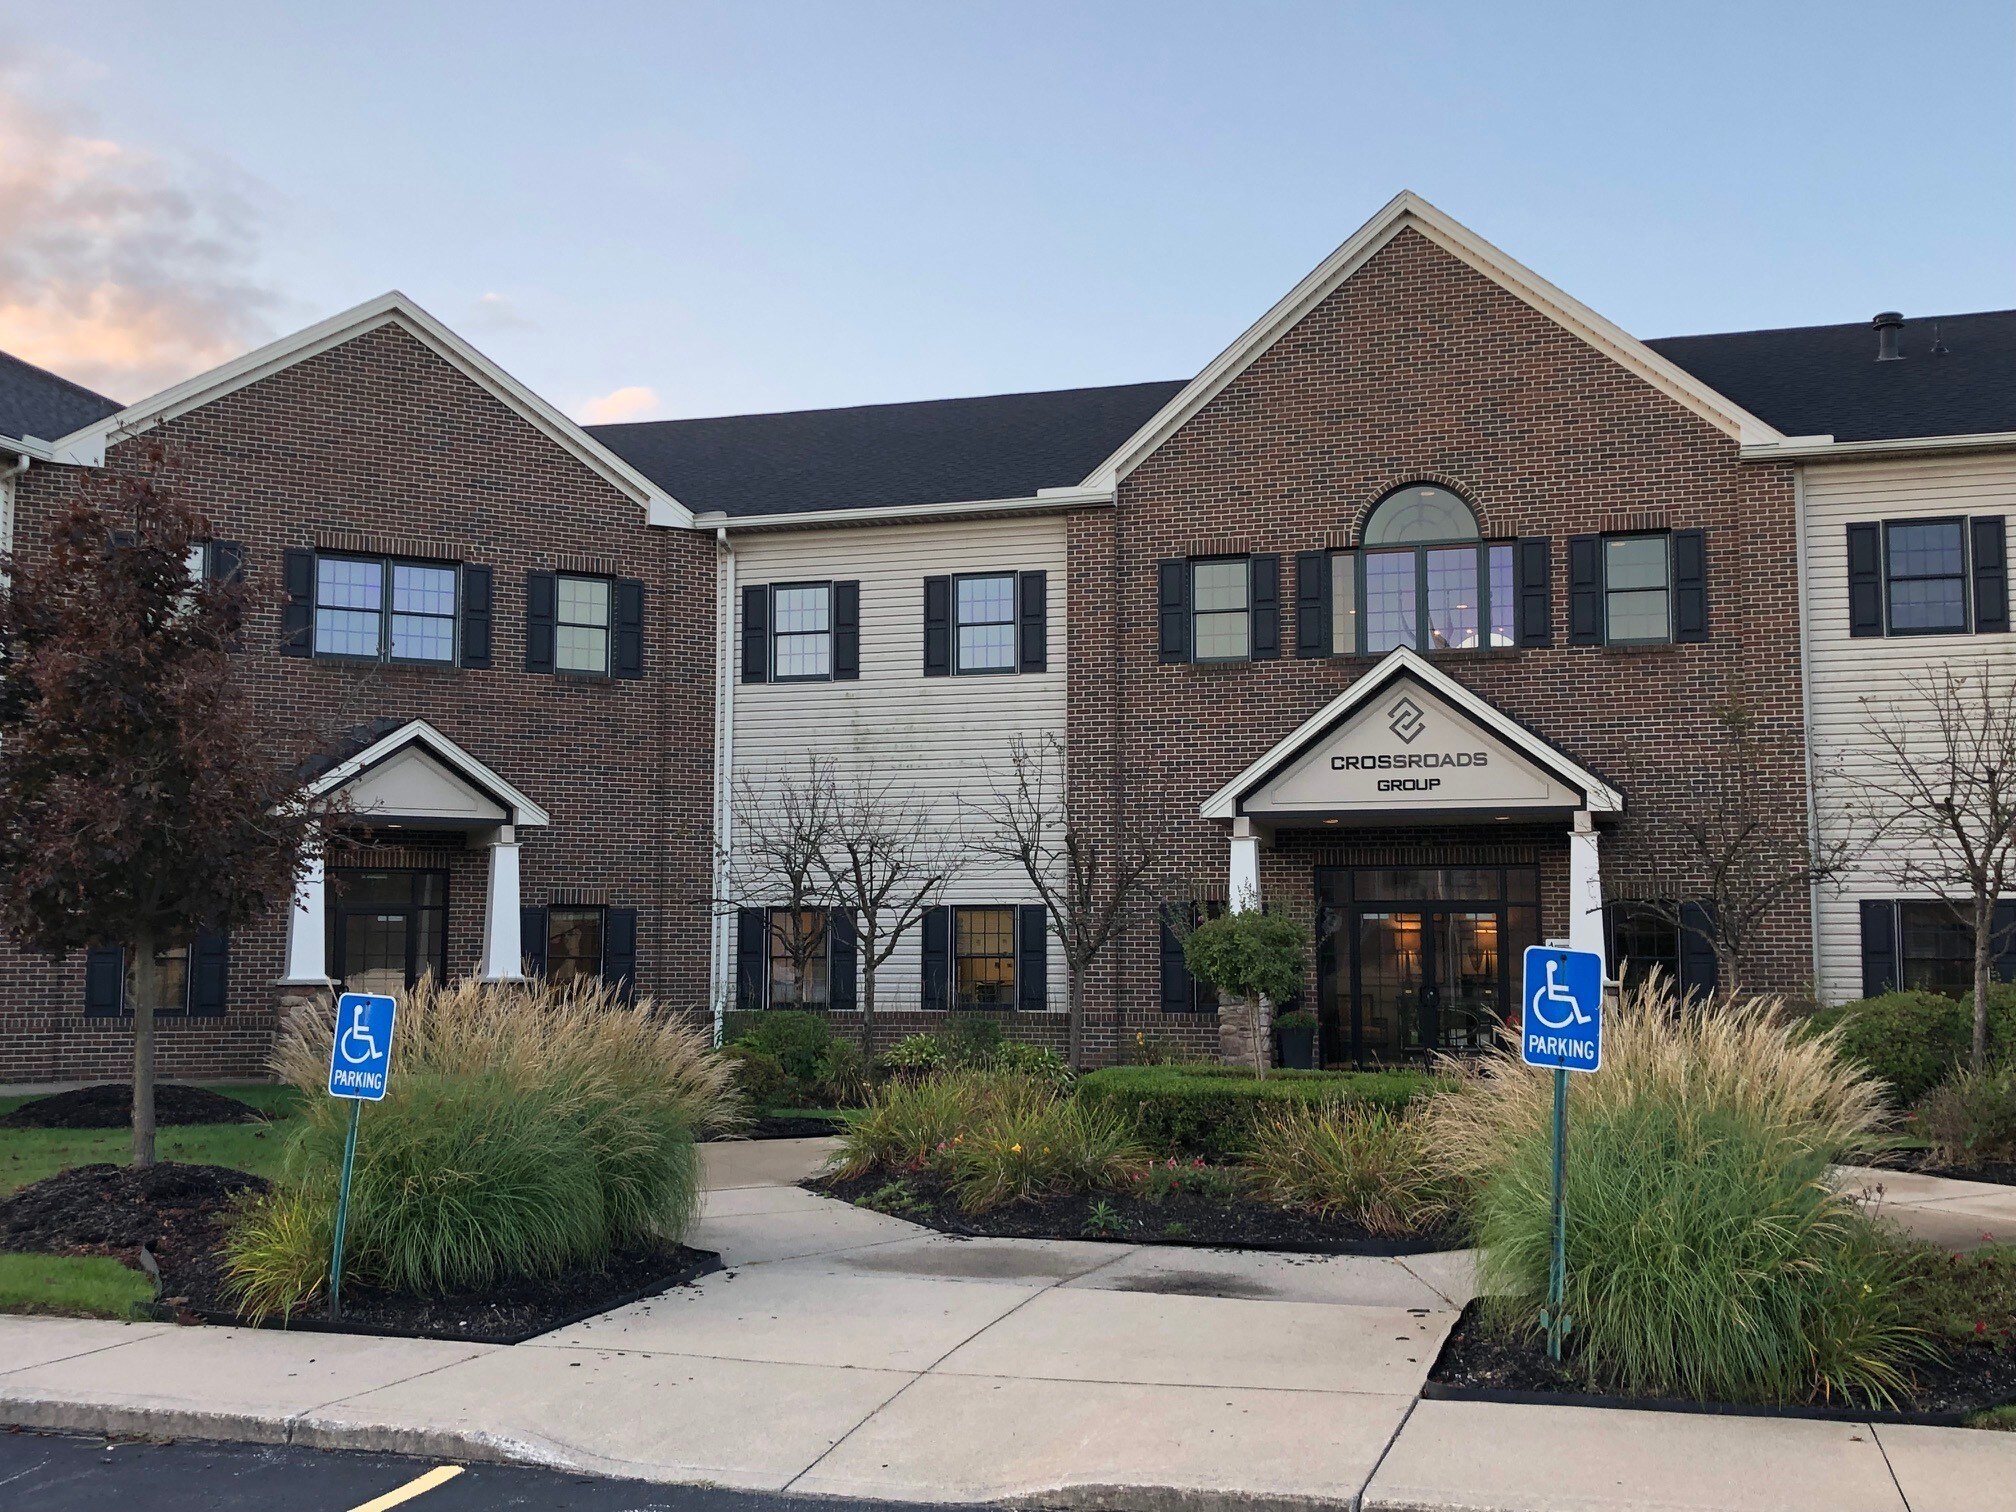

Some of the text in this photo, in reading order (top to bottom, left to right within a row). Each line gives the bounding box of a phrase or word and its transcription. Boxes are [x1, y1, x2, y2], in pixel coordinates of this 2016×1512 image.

[1331, 752, 1488, 770] CROSSROADS
[1377, 778, 1441, 792] GROUP
[1529, 1034, 1595, 1060] PARKING
[334, 1069, 382, 1090] PARKING
